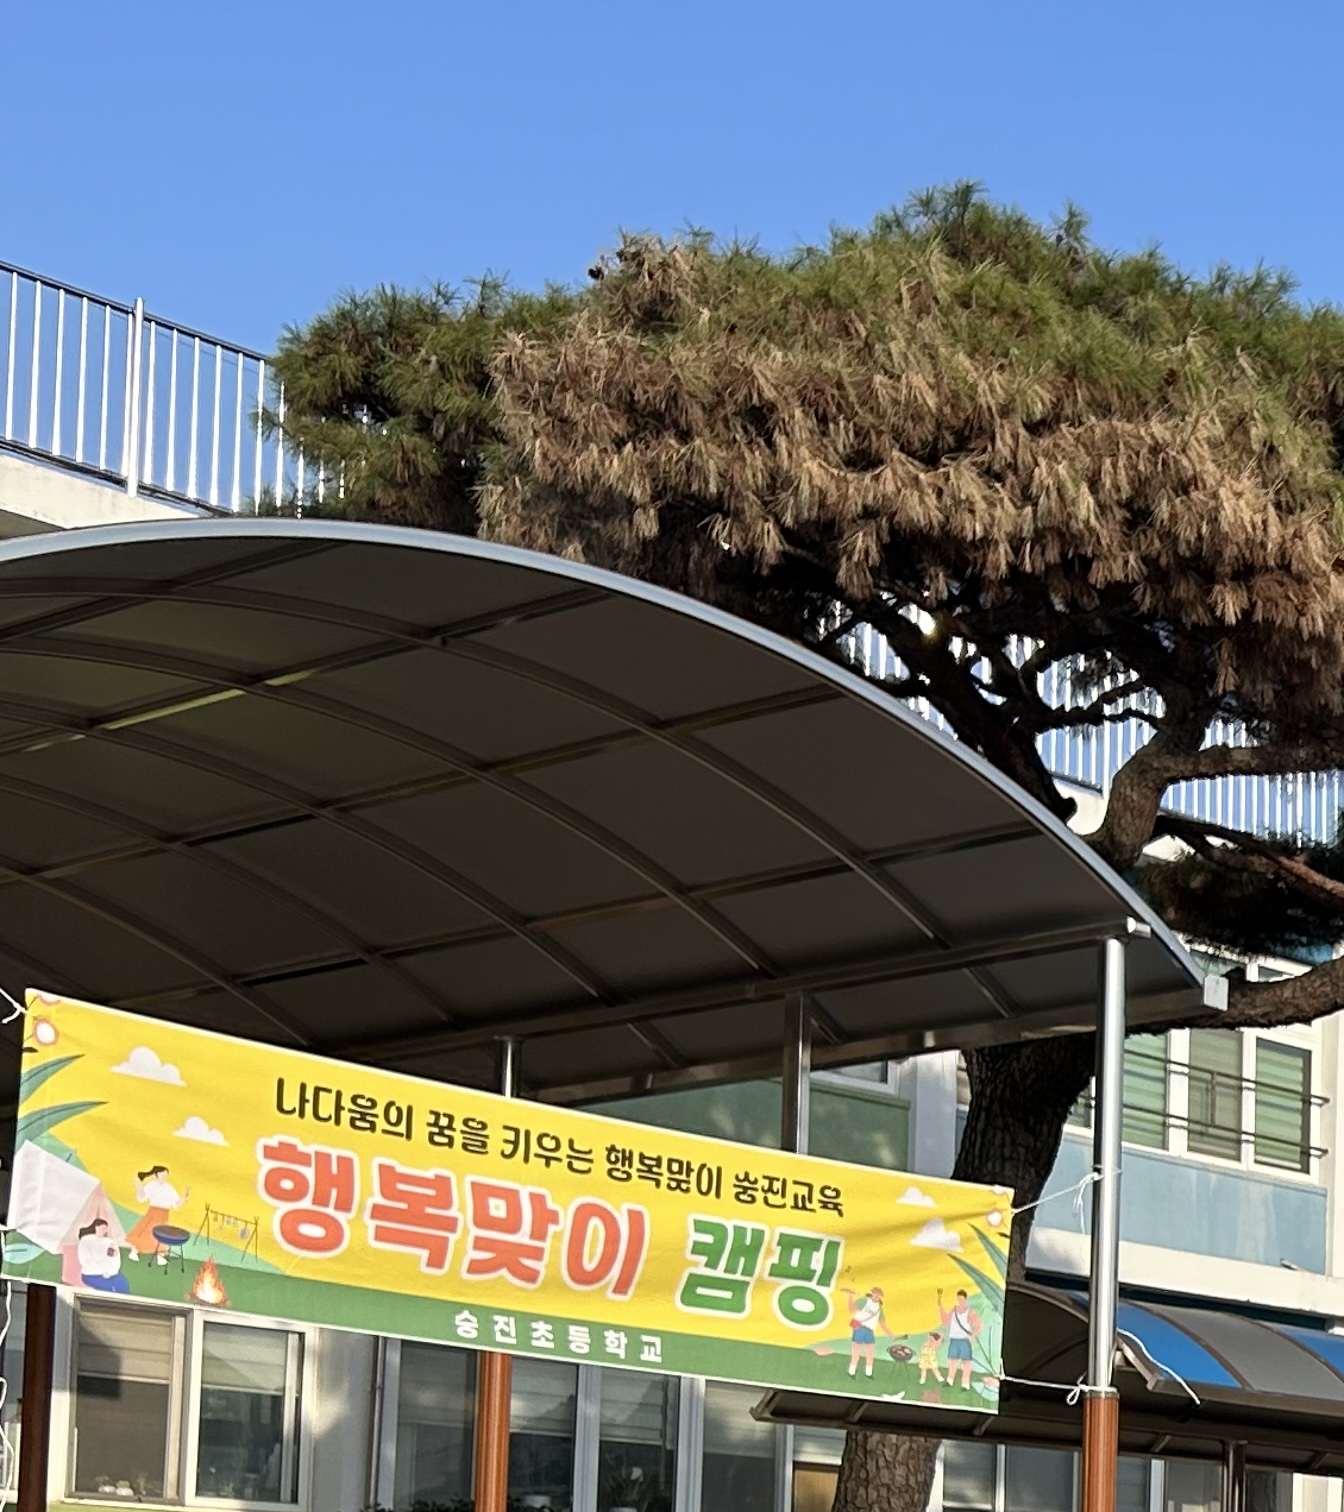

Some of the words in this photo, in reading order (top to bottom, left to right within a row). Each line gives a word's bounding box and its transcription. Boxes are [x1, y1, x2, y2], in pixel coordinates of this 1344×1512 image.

[276, 1077, 414, 1142] 나다움의
[426, 1108, 490, 1156] 꿈을
[501, 1124, 595, 1175] 키우는
[605, 1143, 723, 1200] 행복맞이
[733, 1170, 844, 1218] 숭진교육
[262, 1140, 646, 1298] 행복맞이
[679, 1217, 842, 1326] 캠핑
[455, 1309, 663, 1363] 숭진초등학교
